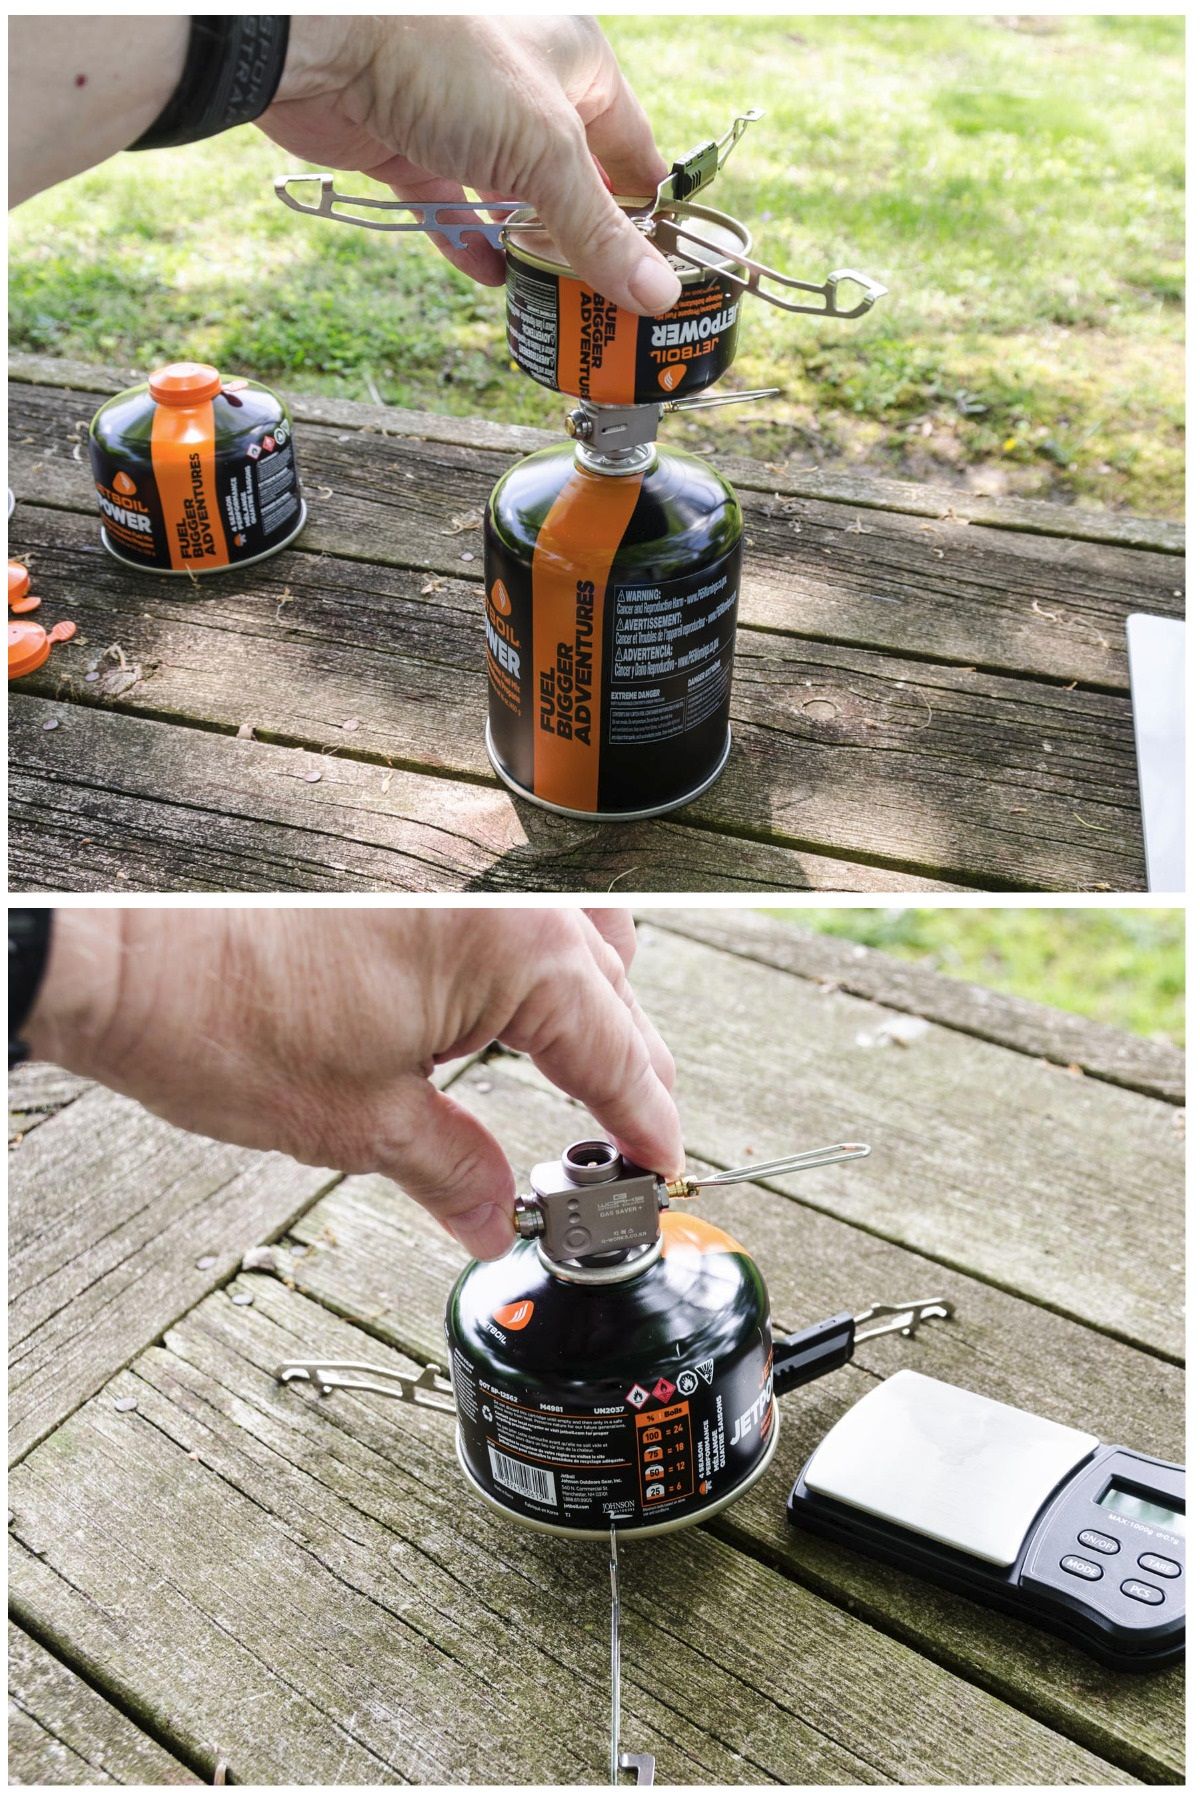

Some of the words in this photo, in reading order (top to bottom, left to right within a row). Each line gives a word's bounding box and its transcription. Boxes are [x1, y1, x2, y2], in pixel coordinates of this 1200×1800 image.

[591, 292, 604, 369] BIGGER
[652, 337, 719, 363] JETBOIL
[189, 452, 216, 556] ADVENTURES
[183, 498, 204, 558] BIGGER
[175, 518, 192, 559] FUEL
[625, 589, 661, 602] WARNING:
[616, 603, 633, 615] Cancer
[634, 603, 643, 613] and
[624, 612, 682, 631] AVERTISSEMENT:
[615, 632, 631, 645] Cancer
[632, 633, 638, 644] et
[623, 644, 673, 661] ADVERTENCIA:
[574, 579, 594, 746] ADVENTURES
[540, 667, 555, 734] FUEL
[556, 642, 573, 741] BIGGER
[611, 691, 637, 700] EXTREME
[638, 688, 660, 699] DANGER
[593, 1406, 625, 1414] UN2037
[664, 1407, 682, 1418] Boils
[730, 1362, 773, 1445] JETPO
[715, 1395, 724, 1432] SAISONS
[645, 1432, 659, 1441] 100
[673, 1424, 683, 1434] 24
[648, 1450, 659, 1459] 75
[703, 1419, 711, 1476] PERFORMANCE
[711, 1429, 720, 1472] MÉLANGE
[650, 1468, 660, 1477] 50
[676, 1461, 686, 1470] 12
[651, 1487, 661, 1496] 25
[676, 1481, 682, 1490] 6
[602, 1500, 635, 1513] JOHNSON
[1080, 1532, 1118, 1551] ON/OFF
[1066, 1558, 1099, 1577] MODE
[1148, 1559, 1173, 1573] TARE
[1130, 1584, 1152, 1598] PCS
